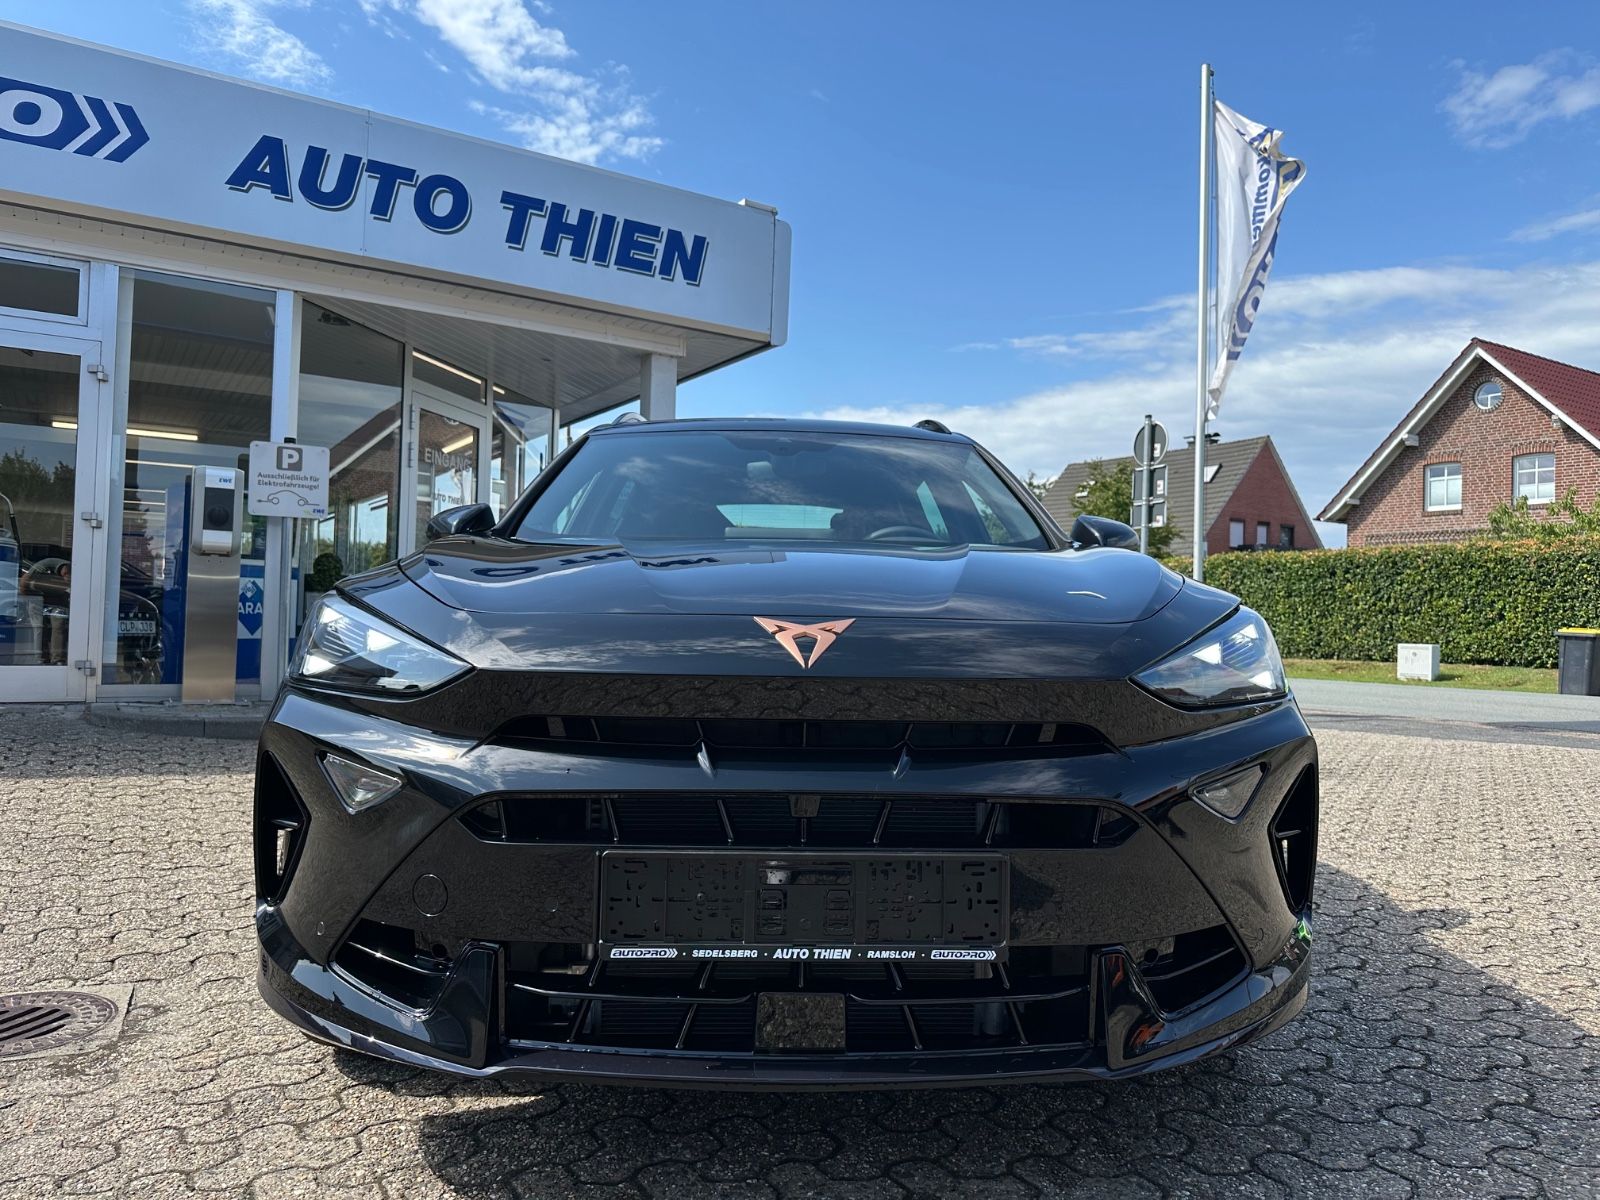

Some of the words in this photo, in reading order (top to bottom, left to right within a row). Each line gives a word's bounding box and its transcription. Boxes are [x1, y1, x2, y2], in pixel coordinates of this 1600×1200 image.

[225, 134, 472, 234] AUTO
[500, 191, 709, 286] THIEN
[281, 448, 300, 469] P
[424, 447, 473, 473] EINGANG
[309, 475, 320, 483] für
[691, 949, 759, 959] SEDELSBERG
[773, 948, 810, 960] AUTO
[812, 948, 852, 960] THIEN
[867, 950, 916, 960] RAMSLOH
